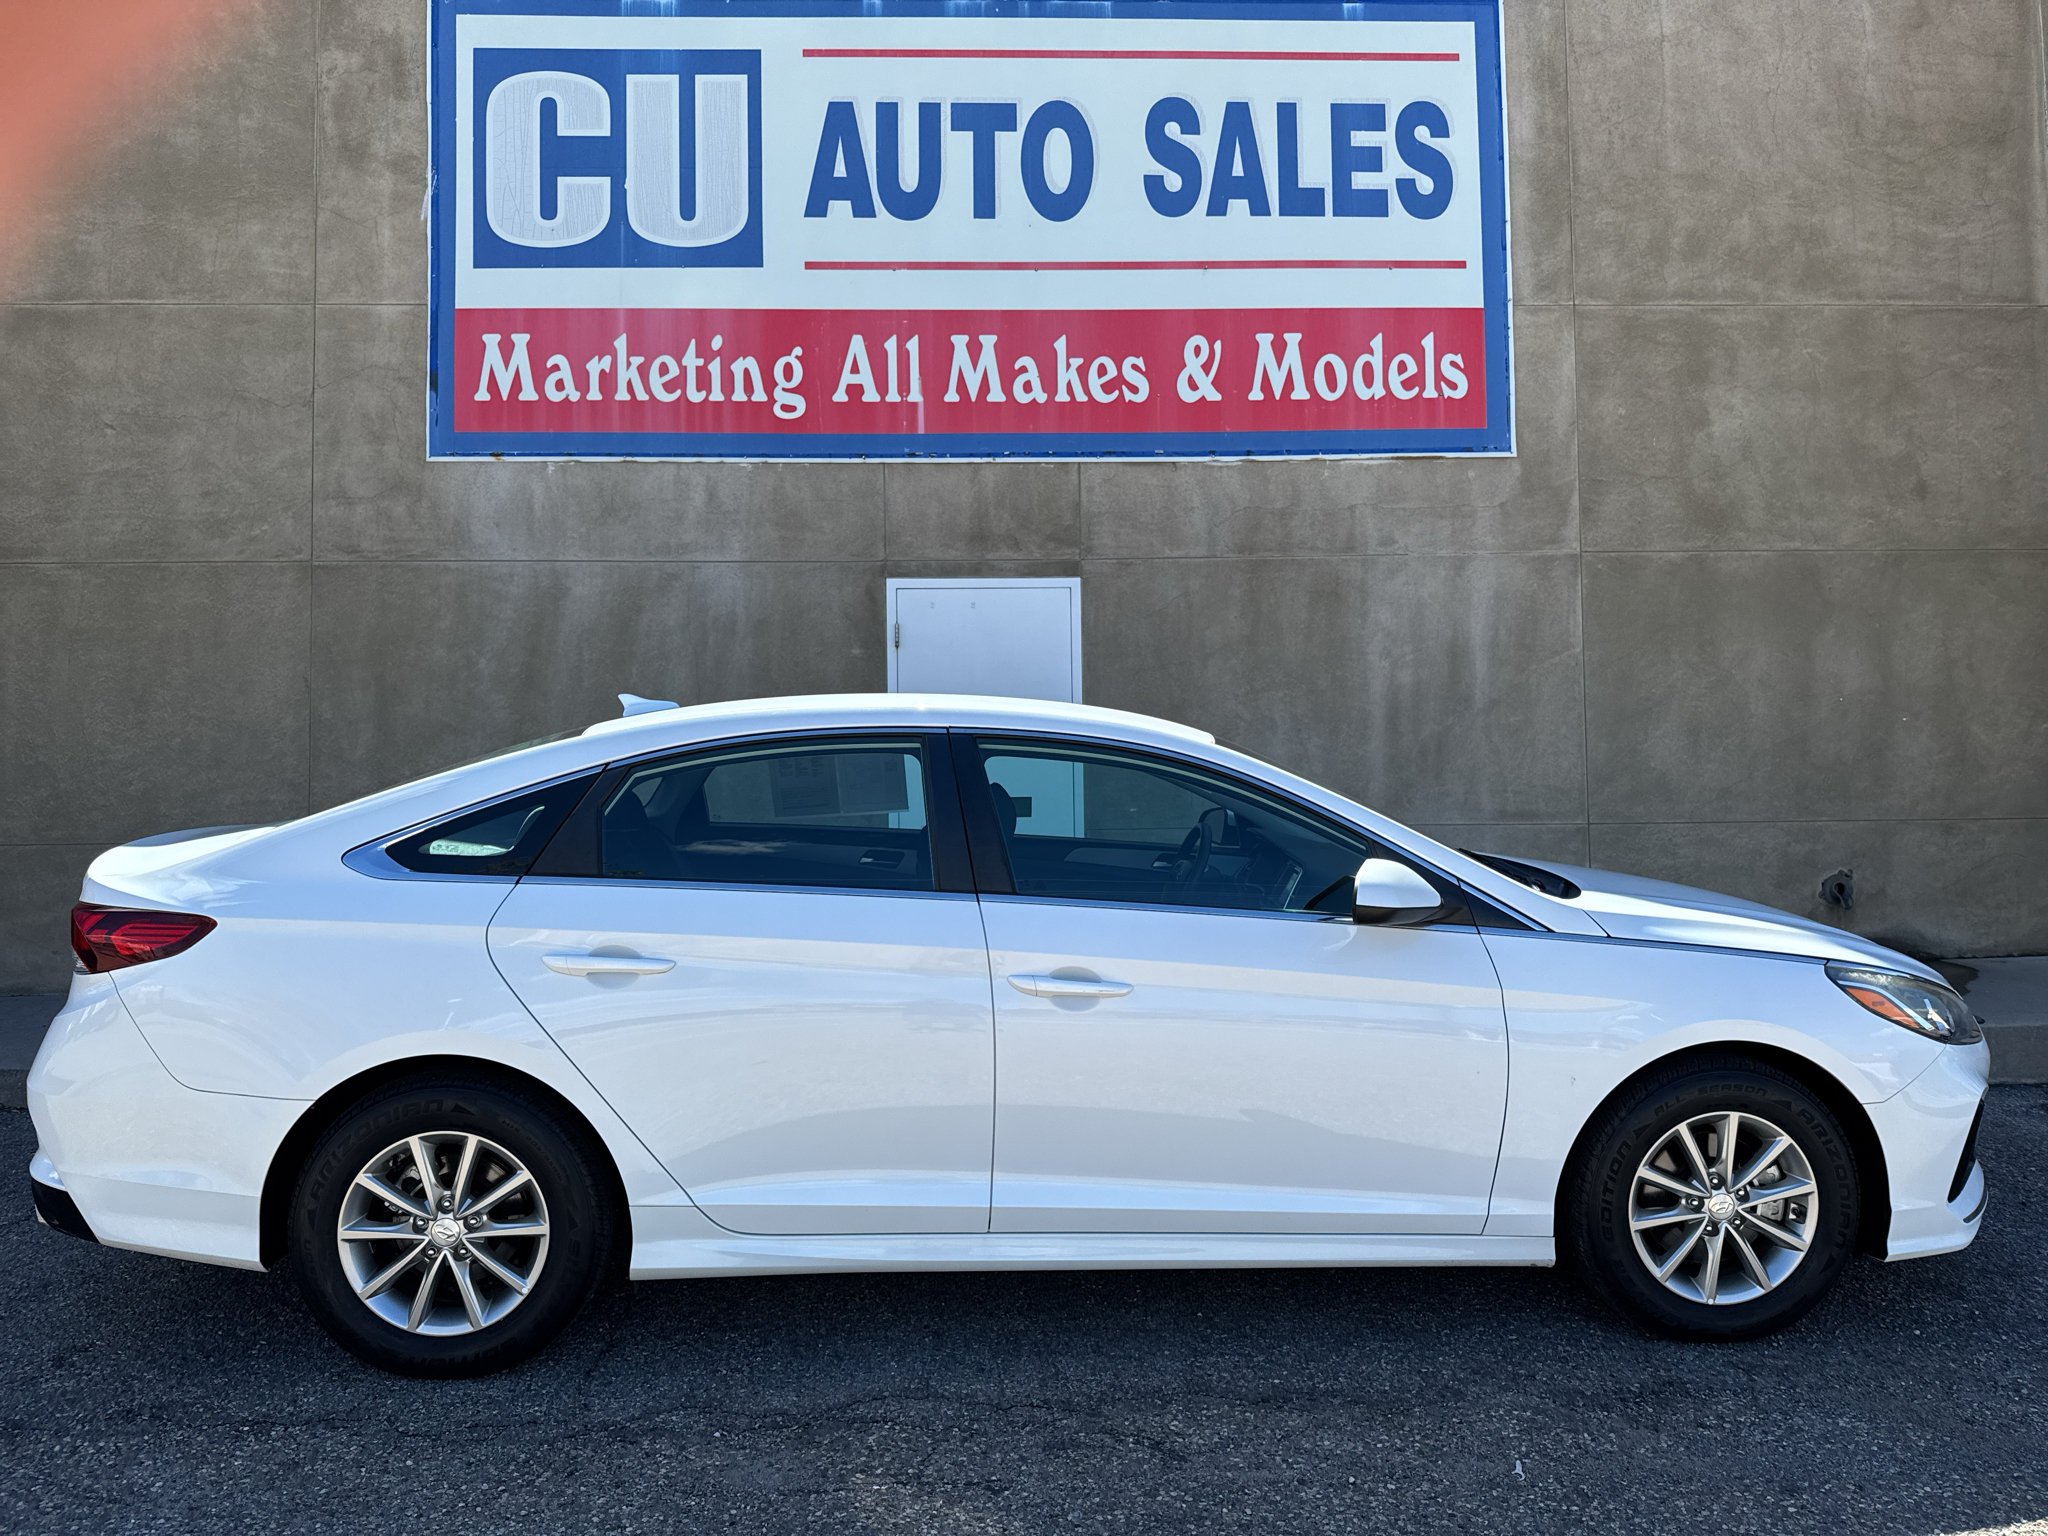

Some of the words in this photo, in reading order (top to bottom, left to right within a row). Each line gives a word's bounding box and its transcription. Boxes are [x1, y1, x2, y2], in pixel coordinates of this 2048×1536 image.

[486, 71, 748, 247] CU
[804, 99, 1095, 222] AUTO
[1143, 97, 1454, 220] SALES
[474, 333, 806, 419] Marketing
[832, 334, 921, 403] All
[943, 334, 1149, 404] Makes
[1176, 335, 1222, 403] &
[1248, 332, 1469, 401] Models
